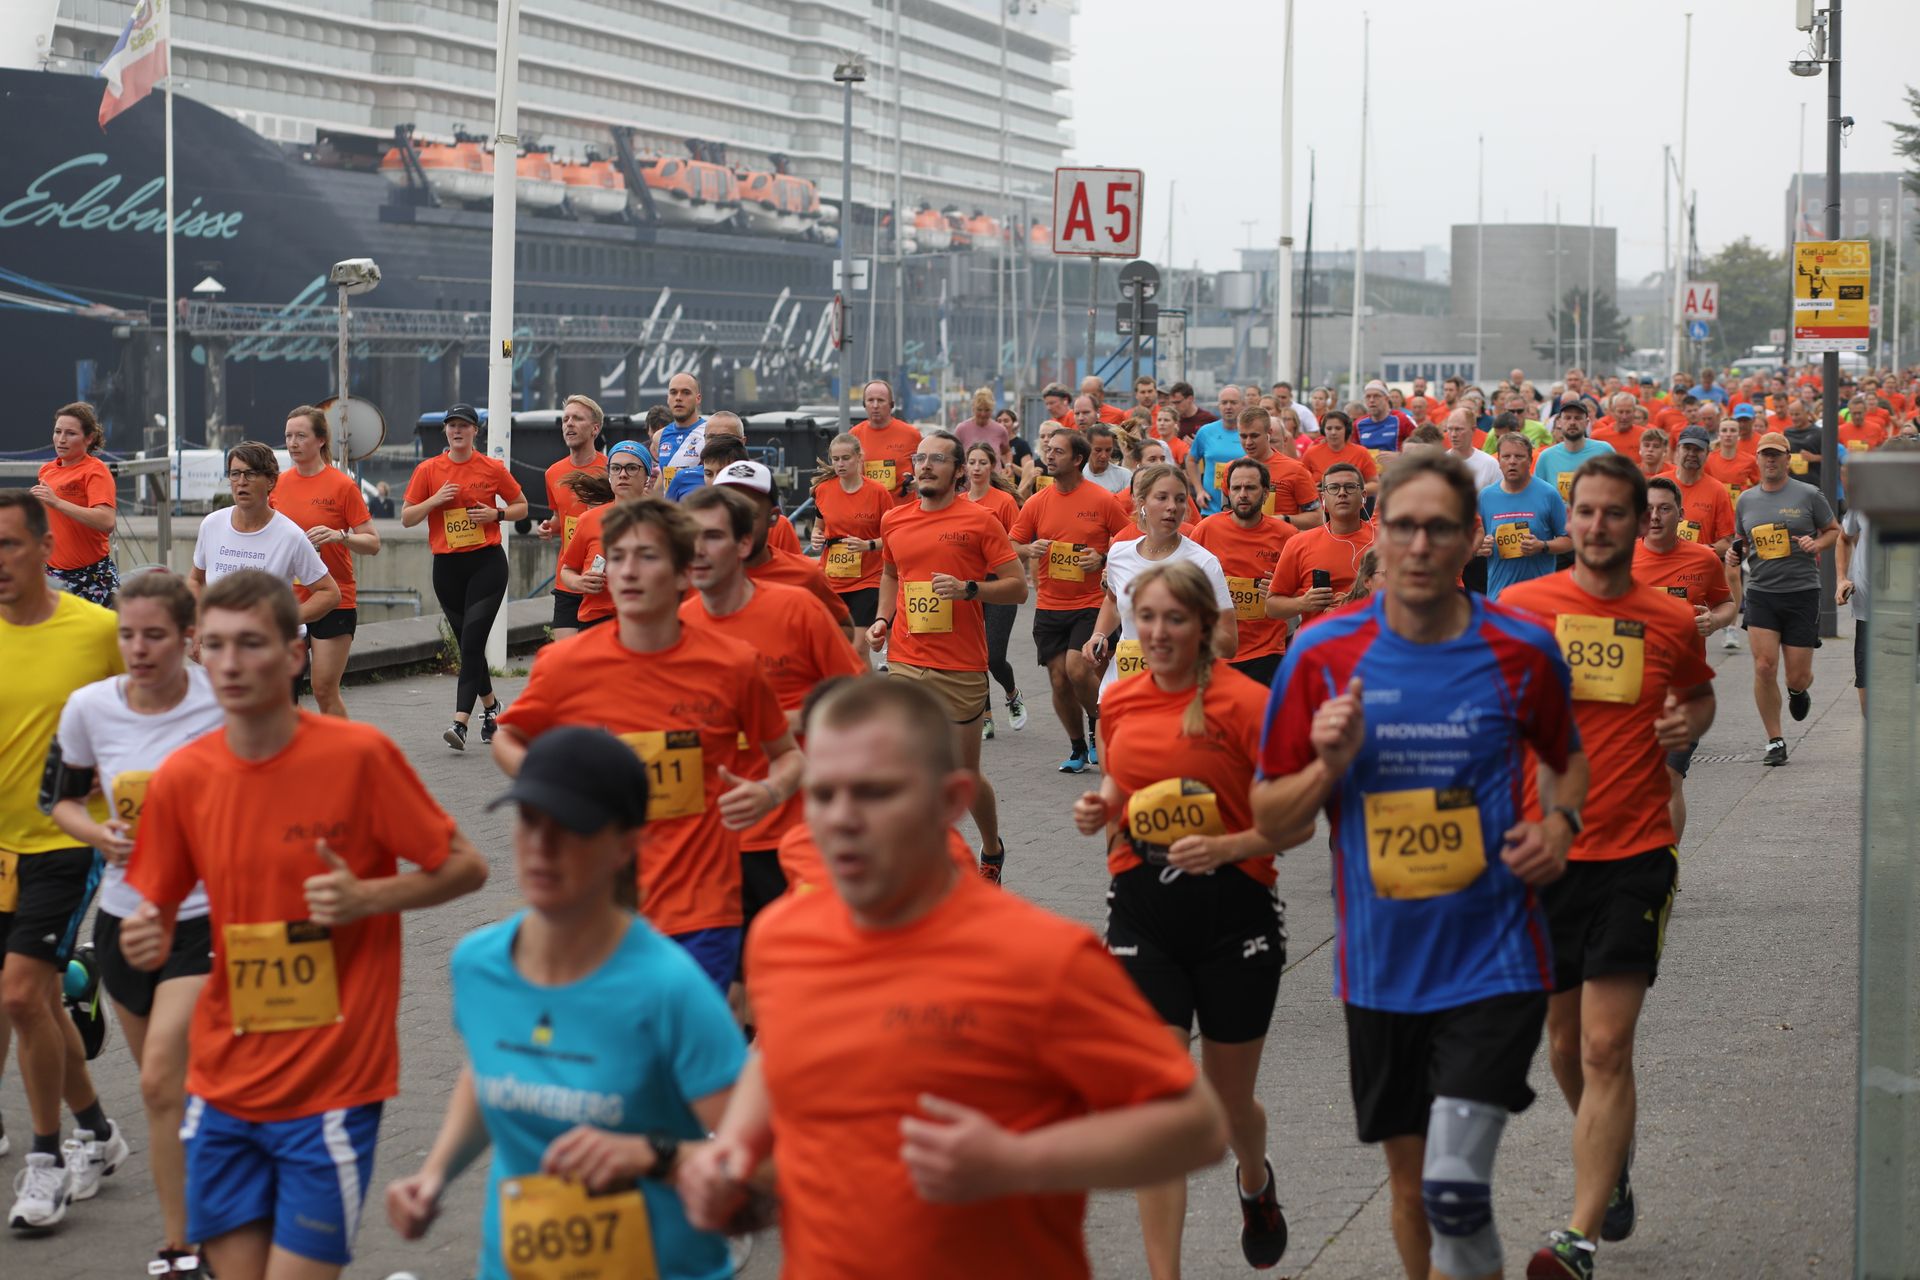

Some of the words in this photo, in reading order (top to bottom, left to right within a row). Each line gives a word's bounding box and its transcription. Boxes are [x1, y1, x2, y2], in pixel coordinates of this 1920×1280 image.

[0, 153, 243, 238] Erlebnisse
[1838, 243, 1866, 266] 35
[1684, 288, 1714, 314] A4
[446, 519, 477, 533] 6625
[1497, 532, 1526, 546] 6603
[1755, 533, 1783, 547] 6142
[220, 545, 266, 560] Gemeinsam
[828, 553, 856, 564] 4684
[1050, 552, 1080, 567] 6249
[215, 562, 238, 573] gegen
[908, 597, 940, 614] 562
[1566, 640, 1625, 669] 839
[1375, 722, 1471, 739] PROVINZIAL
[1134, 803, 1205, 836] 8040
[1373, 821, 1464, 858] 7209
[231, 953, 317, 989] 7710
[510, 1210, 621, 1265] 8697
